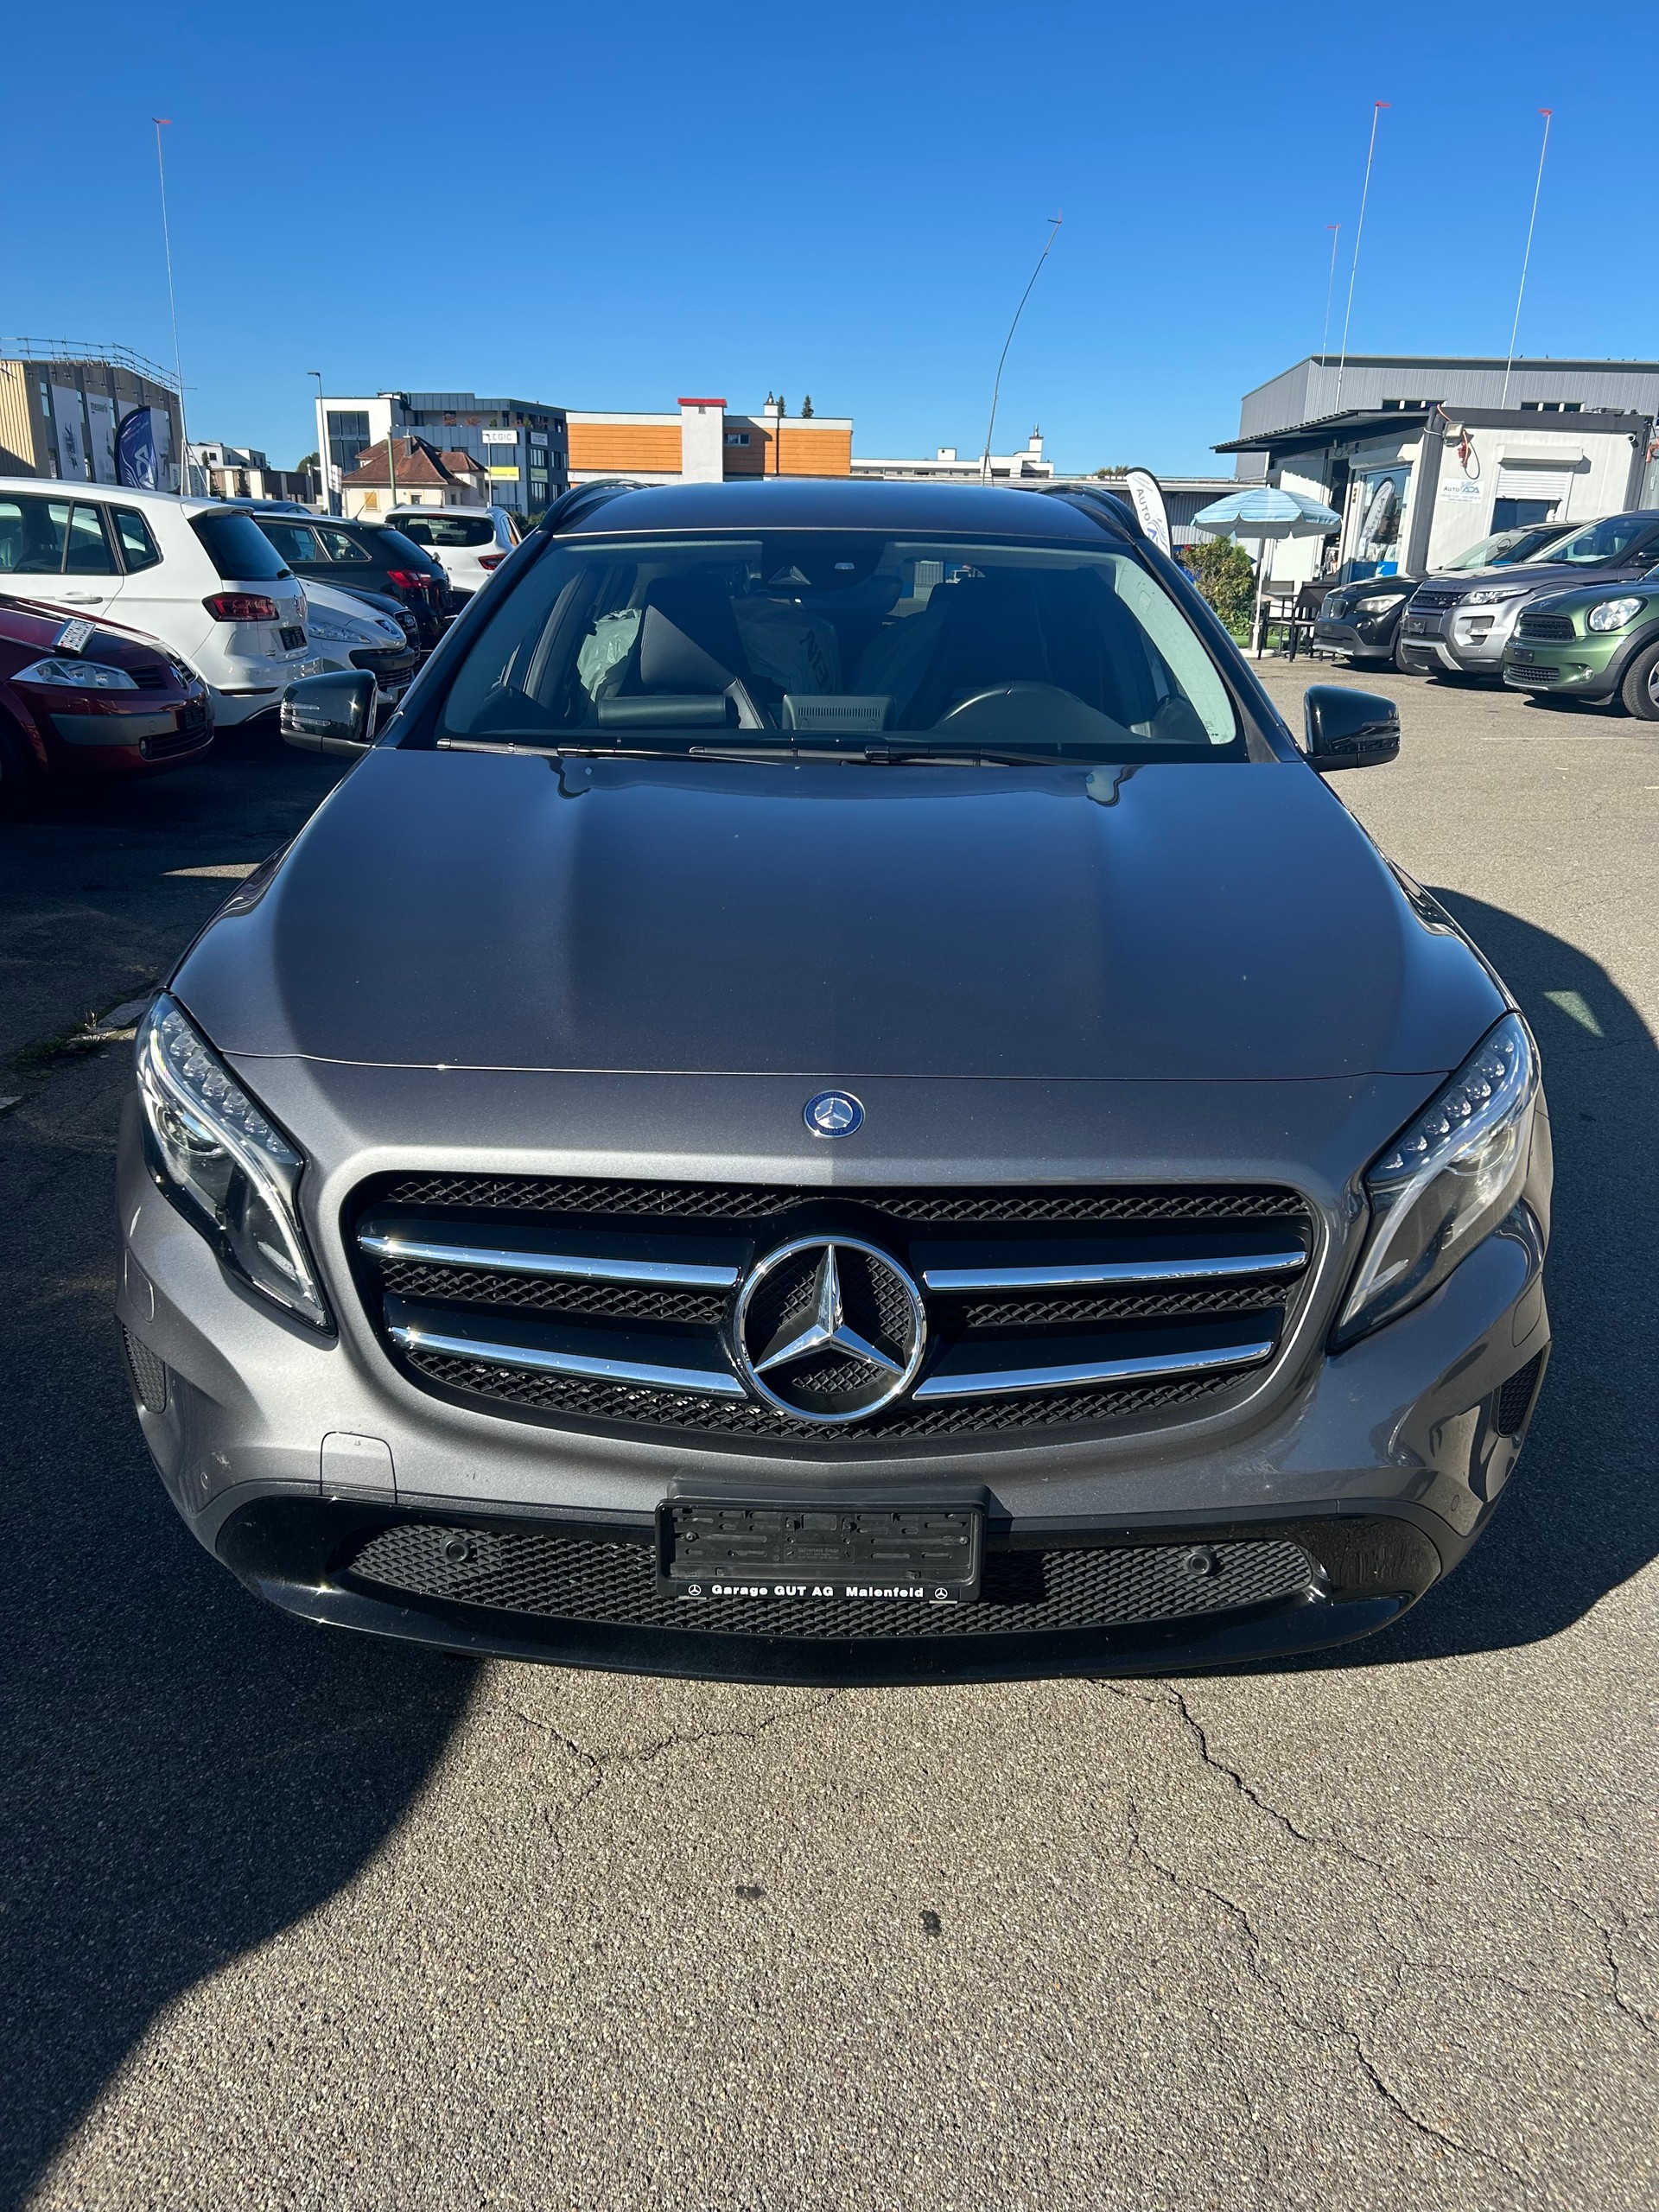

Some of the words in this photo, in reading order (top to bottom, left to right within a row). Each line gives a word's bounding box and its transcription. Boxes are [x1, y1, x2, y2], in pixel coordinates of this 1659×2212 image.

[1136, 489, 1151, 521] AUTO
[711, 1584, 768, 1597] Garage
[774, 1586, 807, 1596] GUT
[812, 1586, 834, 1597] AG
